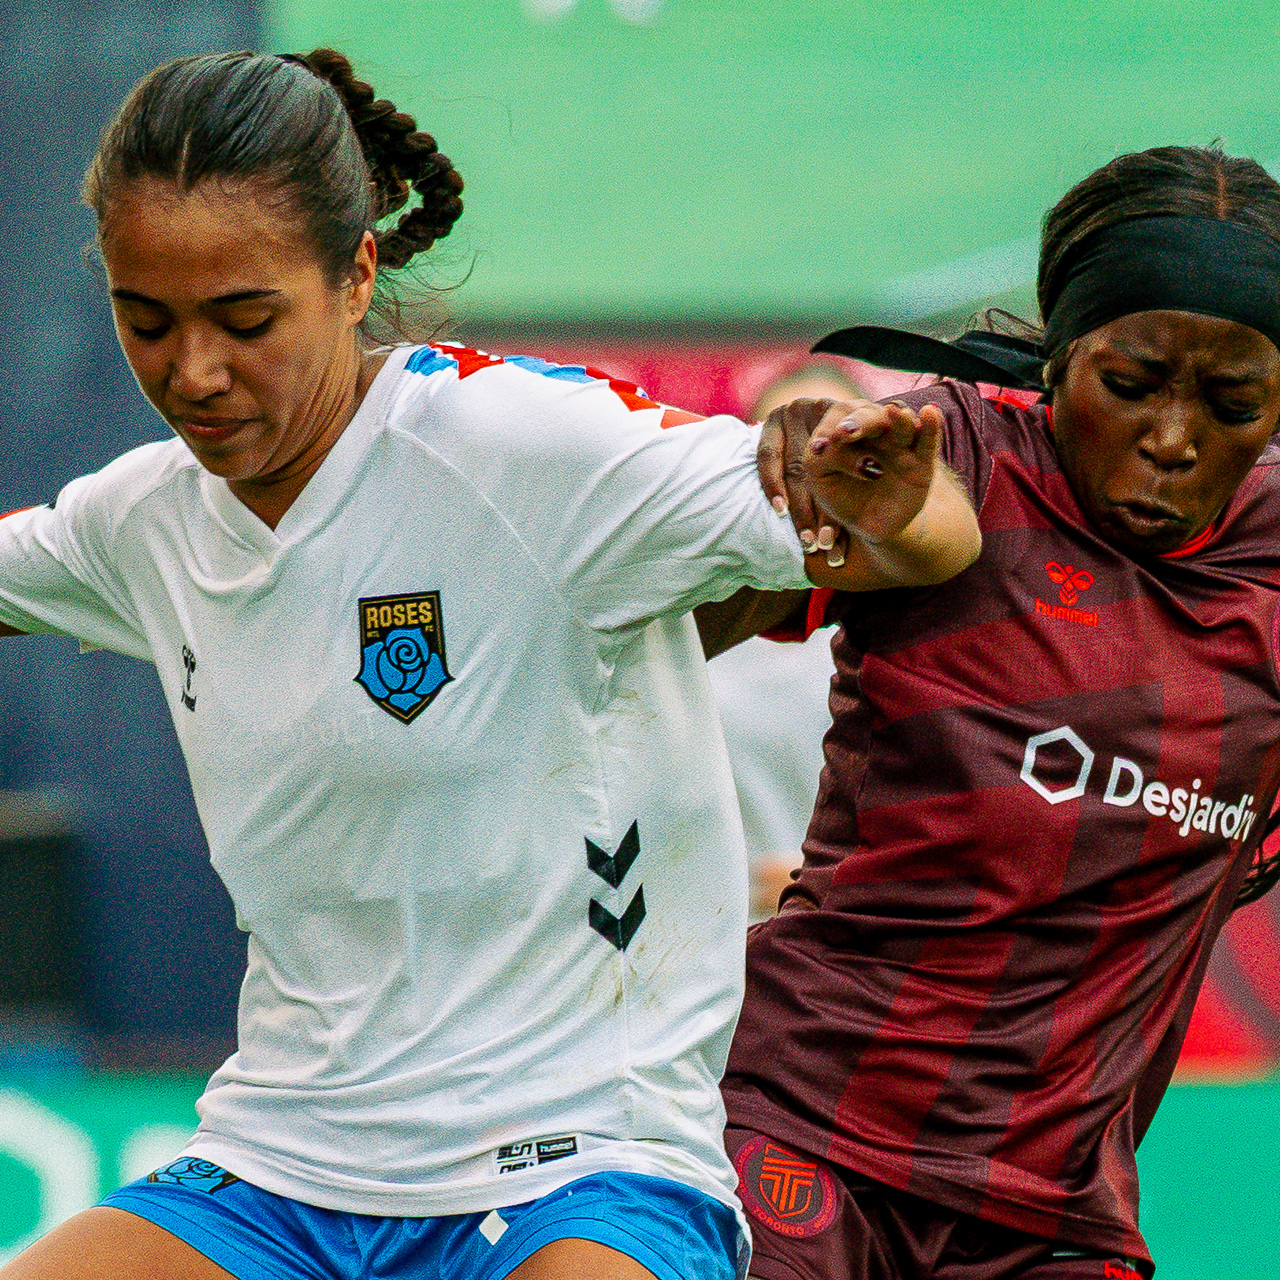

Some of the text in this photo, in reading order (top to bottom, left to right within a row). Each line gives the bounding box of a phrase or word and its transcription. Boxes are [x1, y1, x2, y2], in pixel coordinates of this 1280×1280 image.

[365, 601, 433, 629] ROSES
[1103, 756, 1257, 842] Desjardin
[753, 1205, 805, 1235] TORONTO
